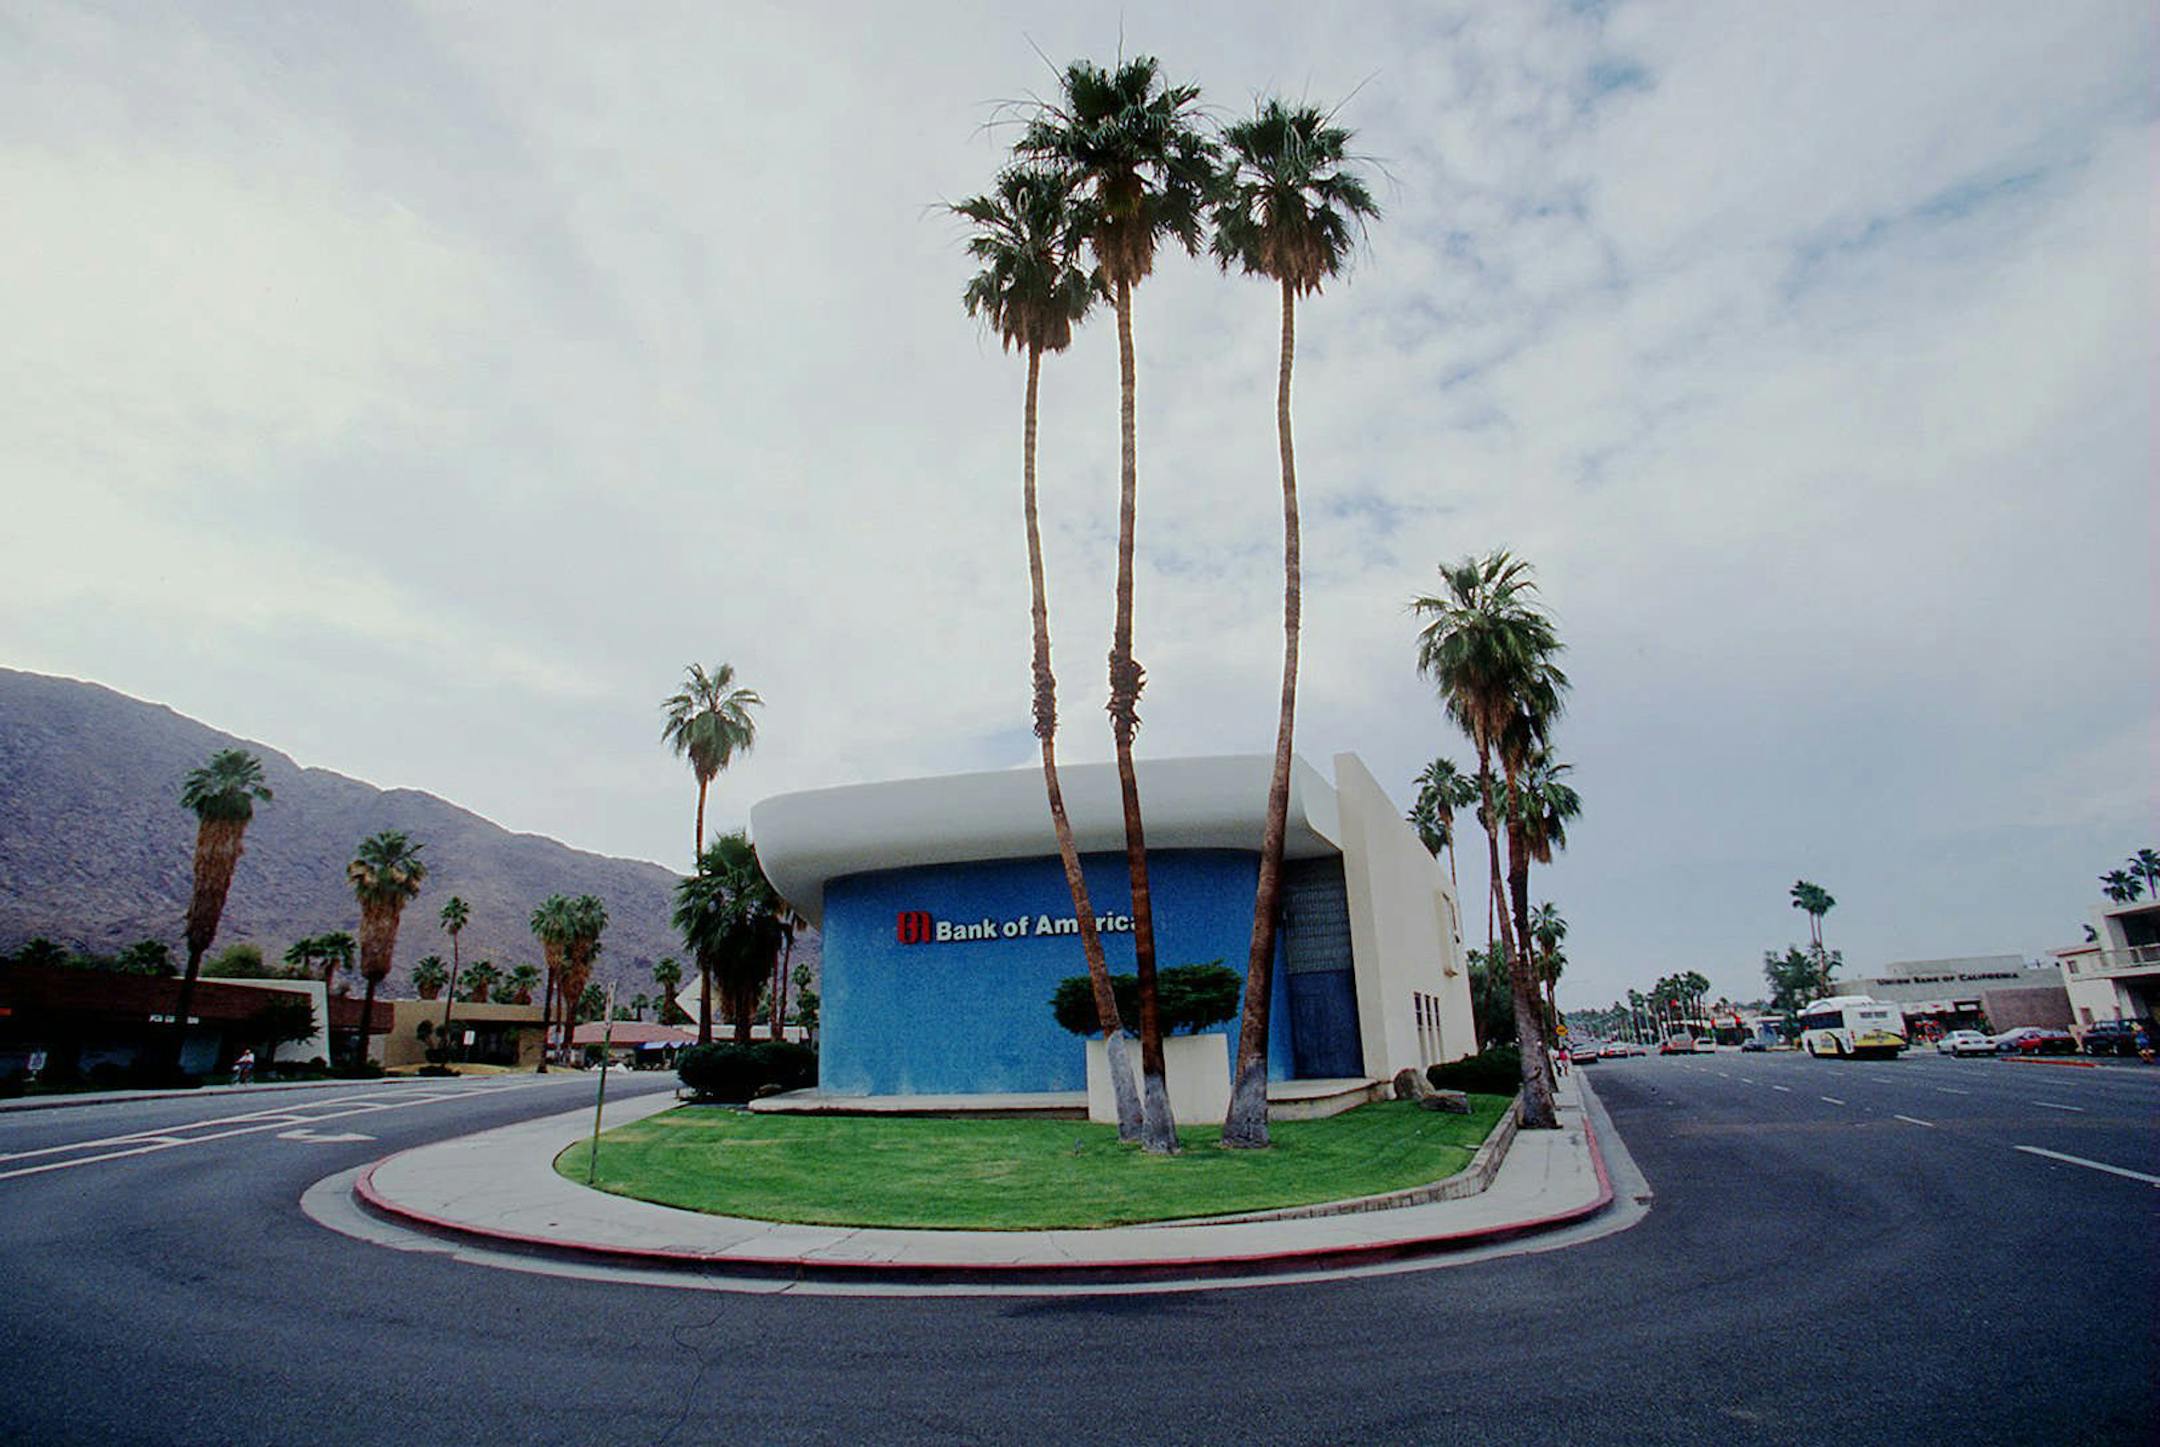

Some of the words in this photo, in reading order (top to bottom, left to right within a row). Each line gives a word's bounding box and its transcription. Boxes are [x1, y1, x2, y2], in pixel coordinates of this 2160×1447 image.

[936, 918, 998, 941] Bank
[1003, 915, 1029, 937] of
[1035, 911, 1136, 935] Amric
